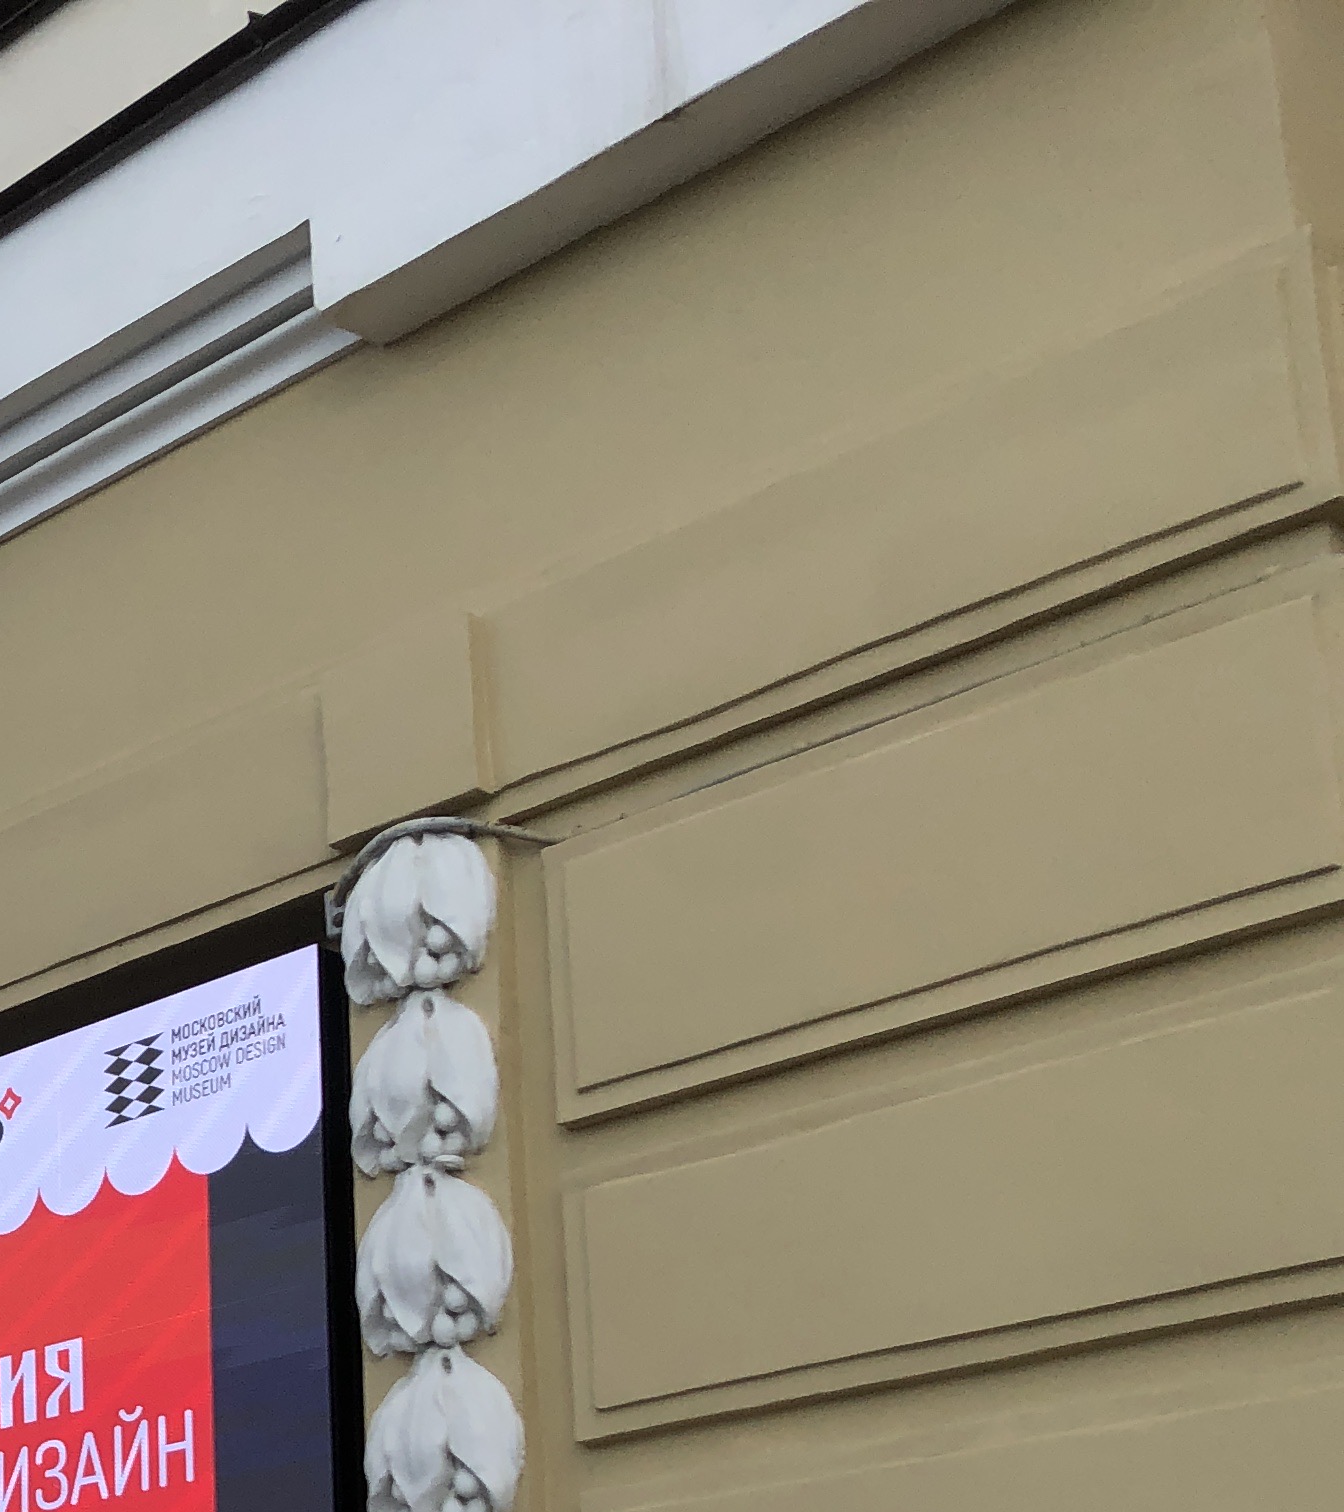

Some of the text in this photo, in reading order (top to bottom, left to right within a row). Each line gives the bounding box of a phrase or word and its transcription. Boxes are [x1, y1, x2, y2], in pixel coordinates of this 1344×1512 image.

[171, 994, 262, 1044] МОСКОВСКИЙ
[171, 1012, 287, 1065] МУЗЕЙ ДИЗАЙНА
[172, 1033, 286, 1086] MOSCOW DESIGN
[172, 1073, 231, 1106] MUSEUM
